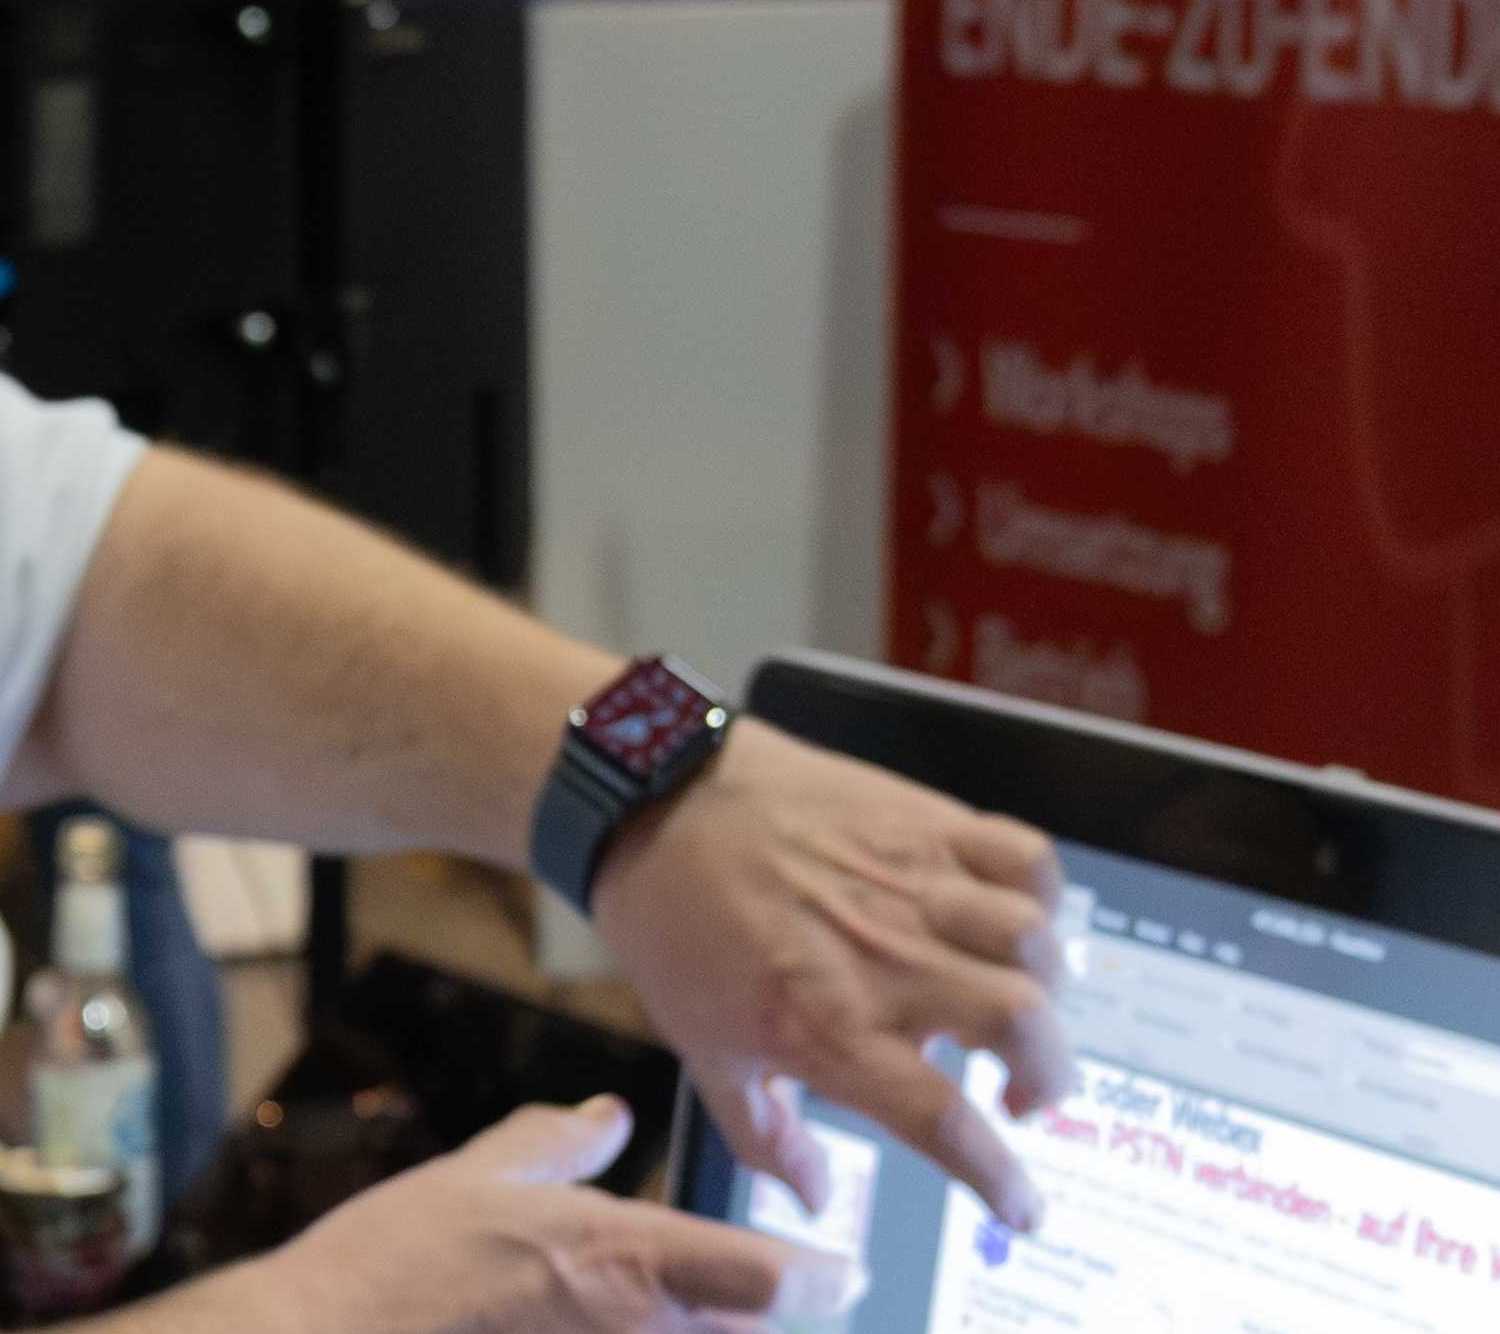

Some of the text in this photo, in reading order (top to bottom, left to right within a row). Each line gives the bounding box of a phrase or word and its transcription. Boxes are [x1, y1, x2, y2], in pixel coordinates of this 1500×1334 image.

[1170, 1089, 1263, 1155] Webex
[1108, 1120, 1184, 1174] PSTN
[1355, 1209, 1410, 1249] auf
[1412, 1215, 1478, 1275] Ihre
